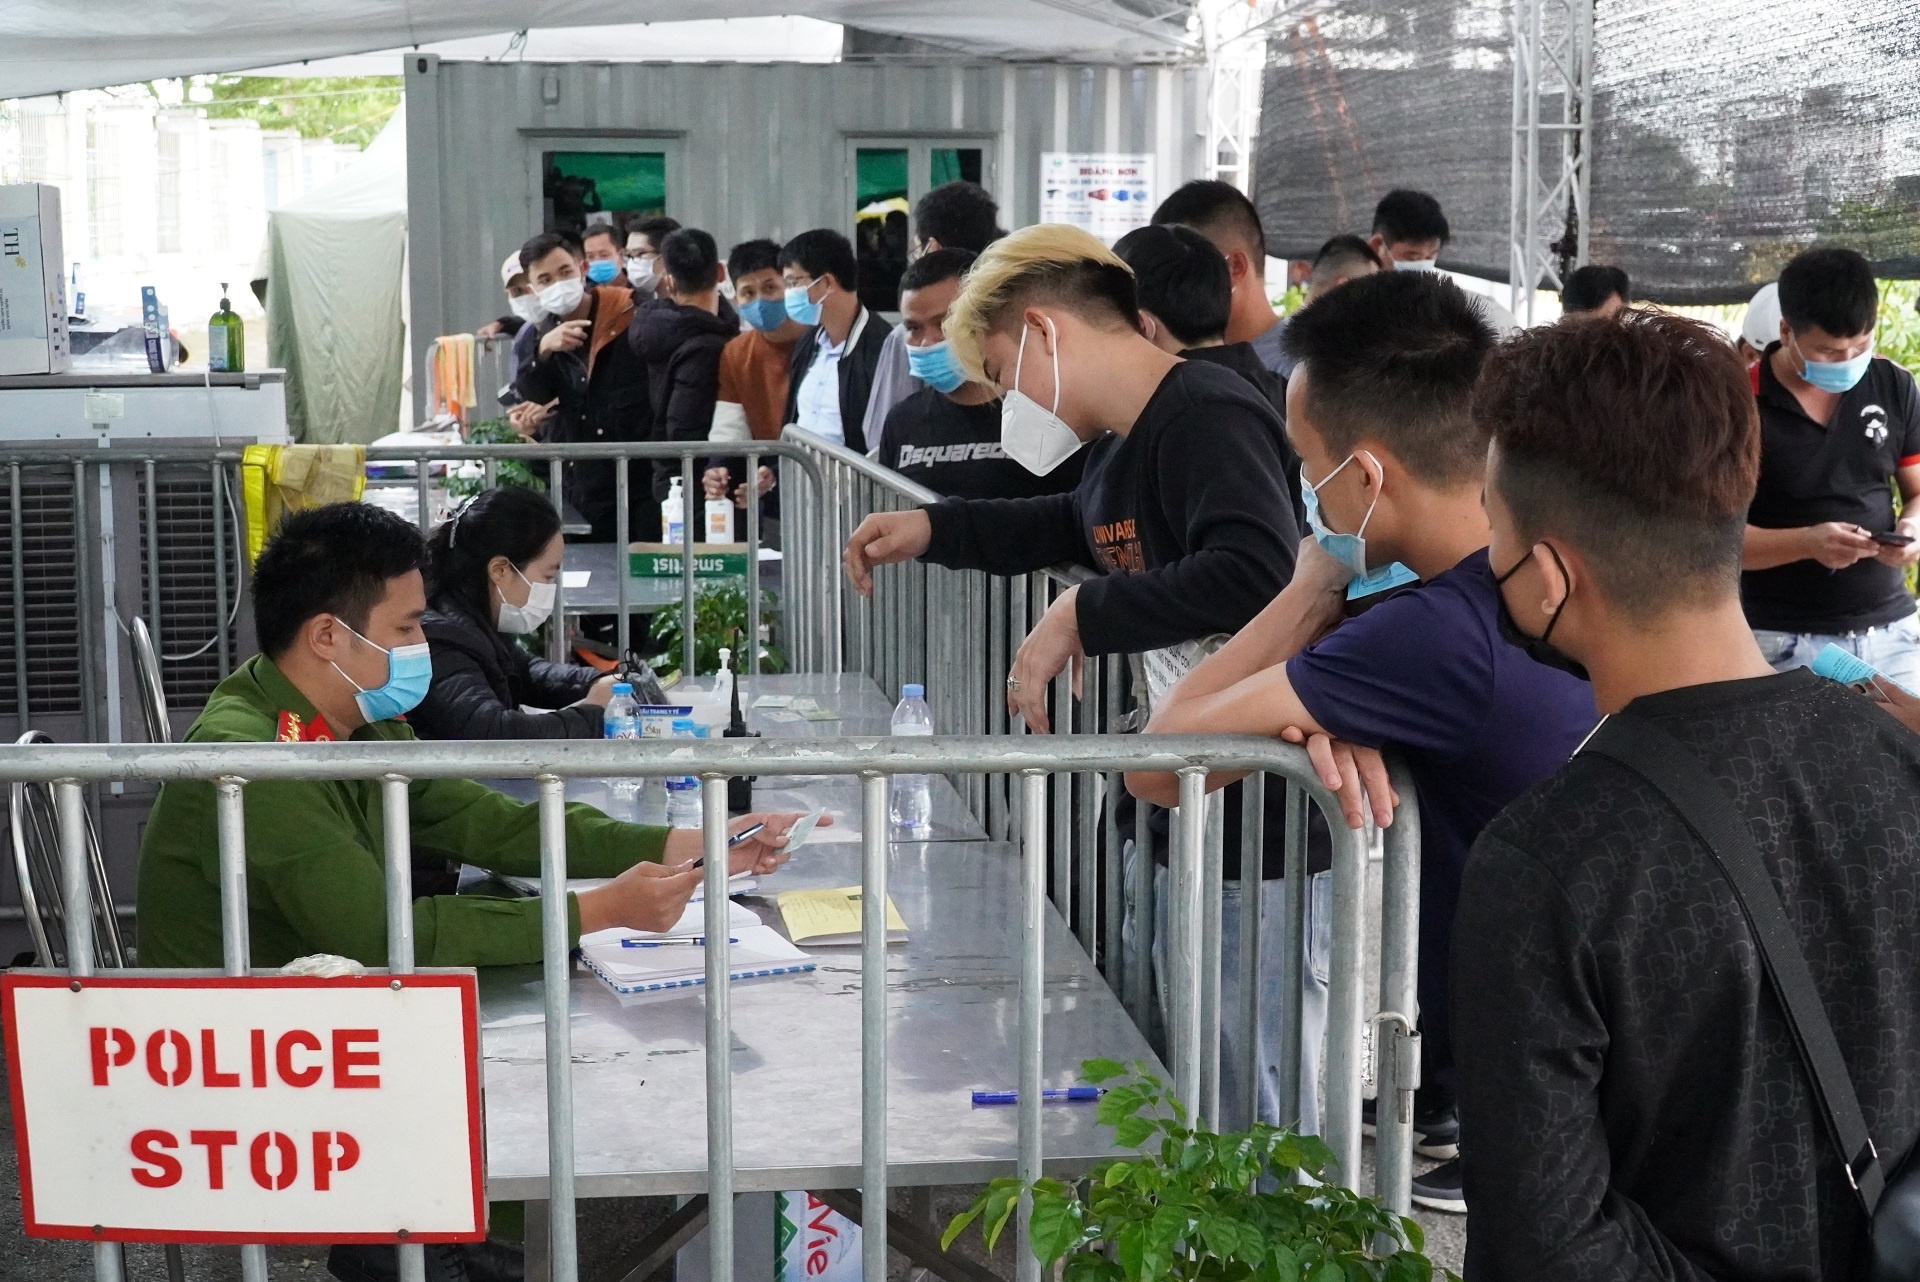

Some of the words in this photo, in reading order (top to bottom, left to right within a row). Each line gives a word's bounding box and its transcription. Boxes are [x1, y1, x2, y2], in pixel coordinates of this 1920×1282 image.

[4, 228, 20, 257] TH
[90, 1027, 381, 1089] POLICE
[130, 1129, 361, 1191] STOP
